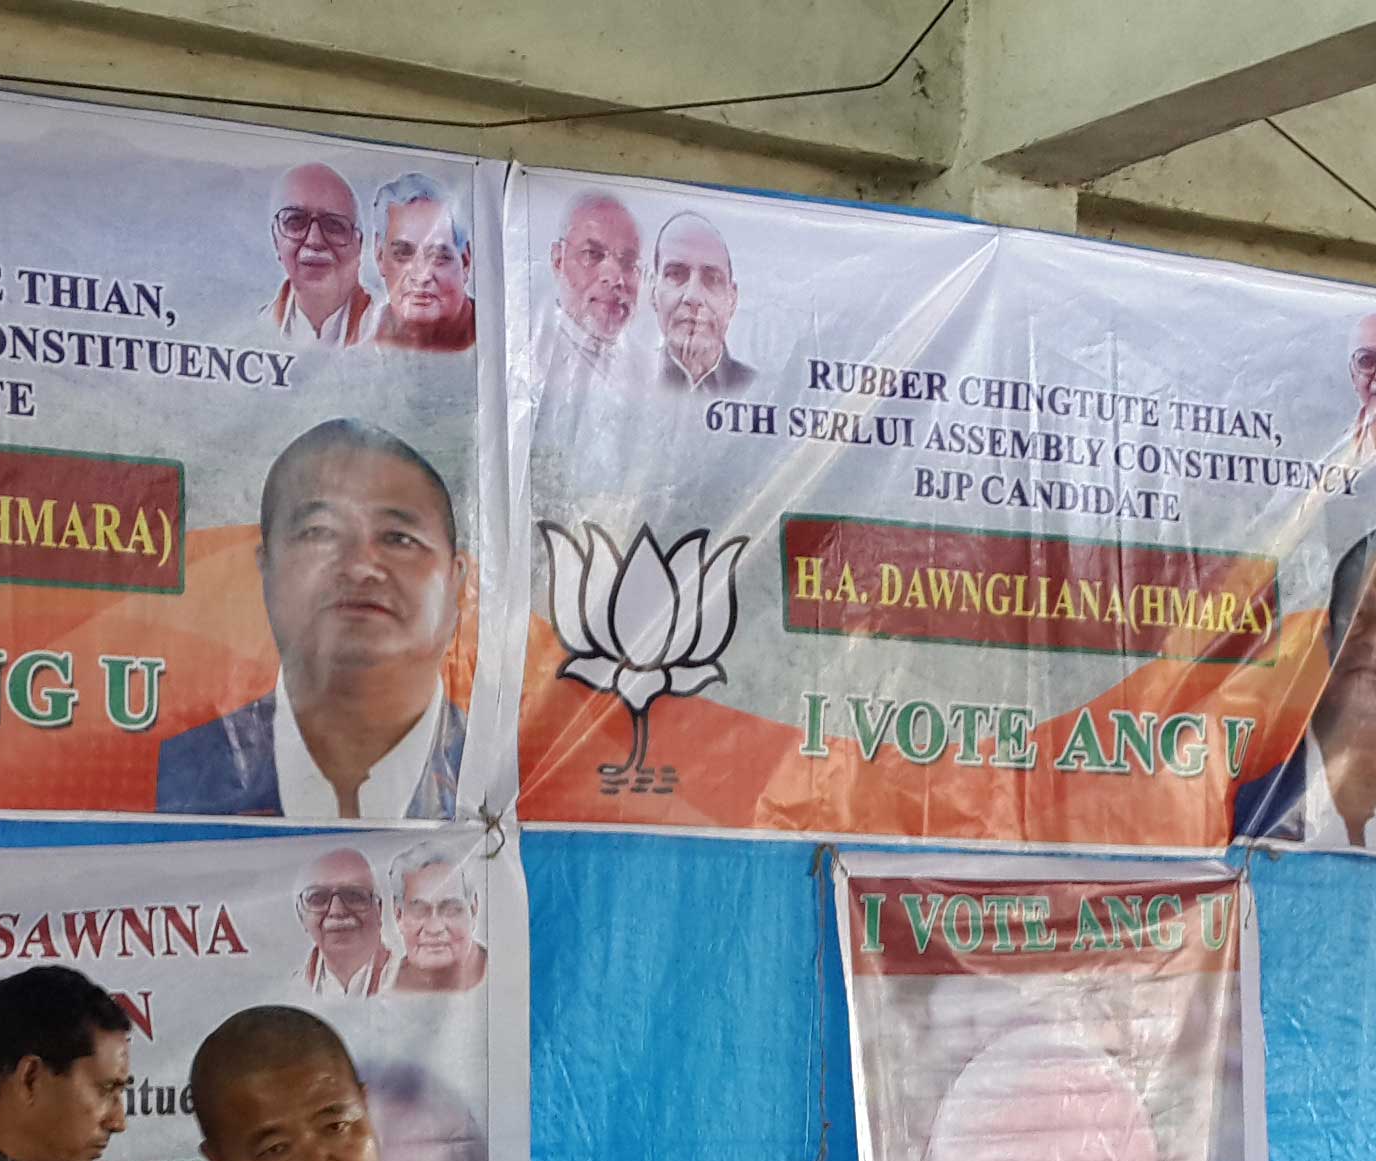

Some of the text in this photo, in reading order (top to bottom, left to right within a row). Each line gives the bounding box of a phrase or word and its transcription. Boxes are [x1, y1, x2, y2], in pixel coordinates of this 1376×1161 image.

[18, 269, 177, 327] THIAN,
[806, 358, 1282, 446] RUBBER CHINGTUTE THIAN,
[705, 398, 1362, 496] 6TH SERLUI ASSEMBLY CONSTITUENCY
[914, 468, 1180, 522] BJP CANDIDATE
[795, 556, 1274, 638] H.A. DAWNGLIANA(HMARA)
[100, 657, 165, 730] U
[799, 694, 1256, 777] I VOTE ANG U
[860, 894, 1233, 954] I VOTE ANG U
